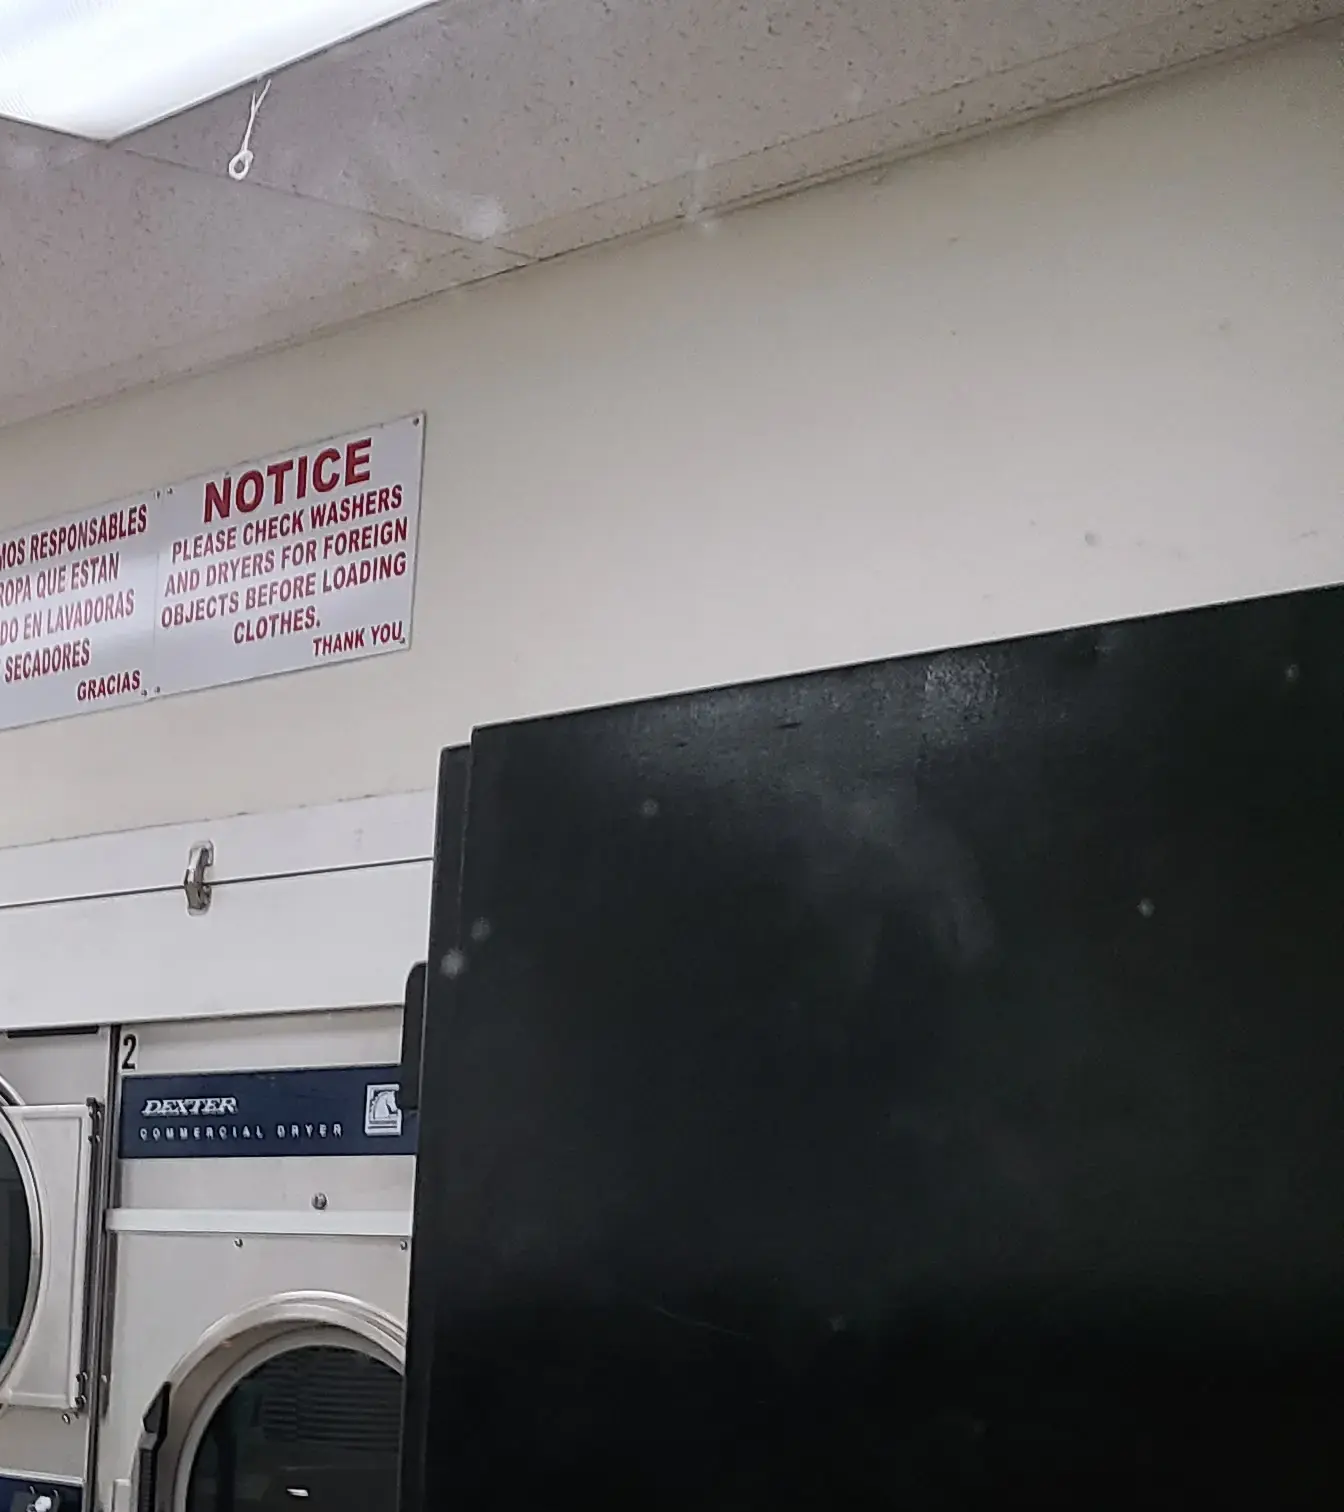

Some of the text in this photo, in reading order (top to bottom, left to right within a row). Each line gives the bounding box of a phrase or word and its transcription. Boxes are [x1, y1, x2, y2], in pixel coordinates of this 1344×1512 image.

[203, 437, 372, 523] NOTICE
[29, 503, 147, 563] RESPONSABLES
[172, 484, 403, 564] PLEASE CHECK WASHERS
[36, 564, 66, 599] QUE
[70, 551, 120, 591] ESTAN
[164, 516, 408, 598] AND DRYERS FOR FOREIGN
[161, 551, 407, 629] OBJECTS BEFORE LOADING
[23, 611, 42, 640] EN
[46, 588, 135, 634] LAVADORAS
[233, 605, 321, 644] CLOTHES.
[4, 638, 90, 684] SECADORES
[313, 627, 365, 657] THANK
[77, 669, 141, 701] GRACIAS
[121, 1034, 136, 1070] 2
[140, 1097, 239, 1117] DEXTER
[139, 1123, 344, 1140] COMMERCIAL DRYER
